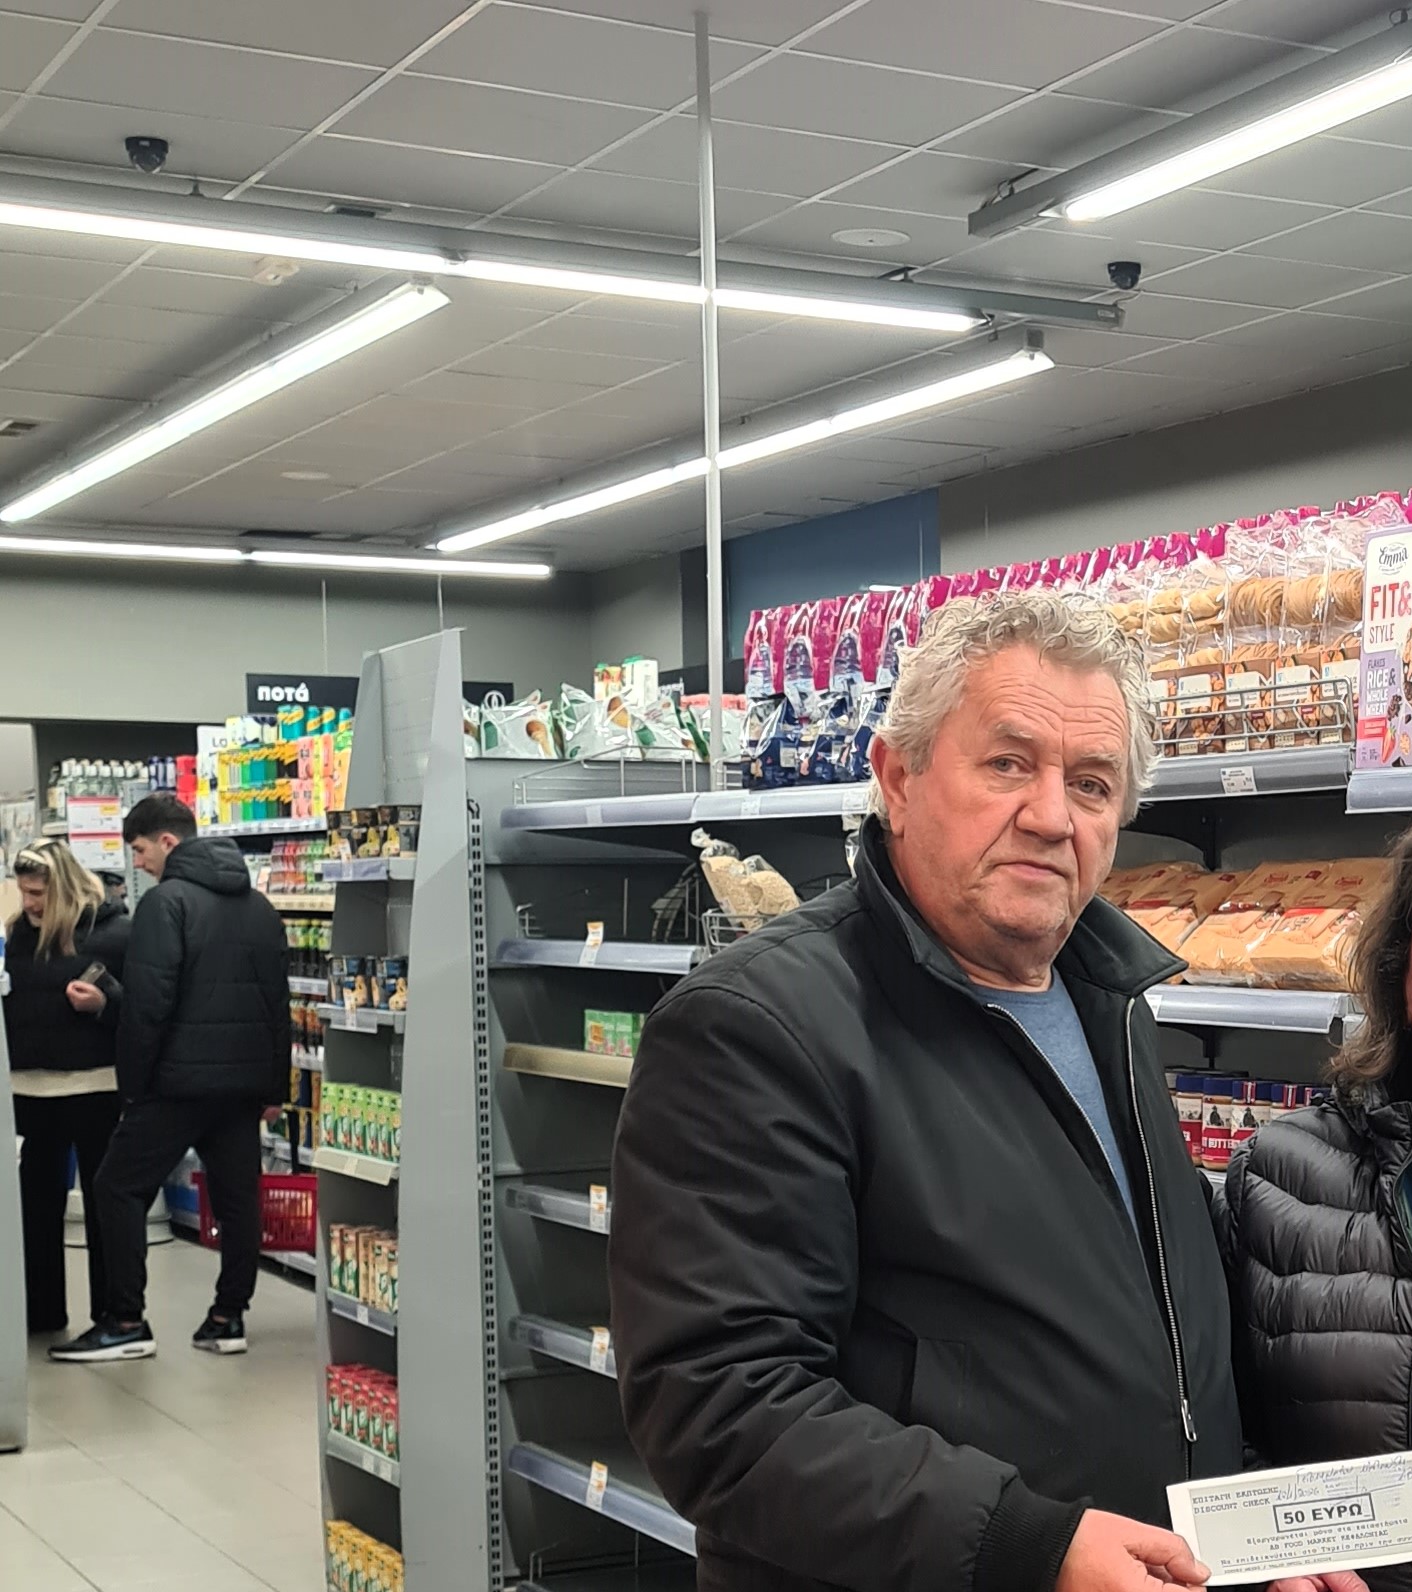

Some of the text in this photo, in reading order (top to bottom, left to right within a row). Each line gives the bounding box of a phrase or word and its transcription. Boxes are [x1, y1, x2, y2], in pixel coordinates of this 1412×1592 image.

[1379, 547, 1409, 568] Emma
[1370, 580, 1412, 621] FIT&
[1369, 623, 1395, 644] STYLE
[257, 683, 309, 703] ποτά
[1366, 689, 1388, 705] WHOLE
[1192, 1492, 1232, 1505] ΕΠΙΤΑΓΗ
[1193, 1498, 1271, 1515] DISCOUNT CHECK
[1283, 1502, 1363, 1525] 50 ΕΥΡΩ
[1285, 1540, 1304, 1550] FOOD
[1307, 1536, 1337, 1547] MARKET
